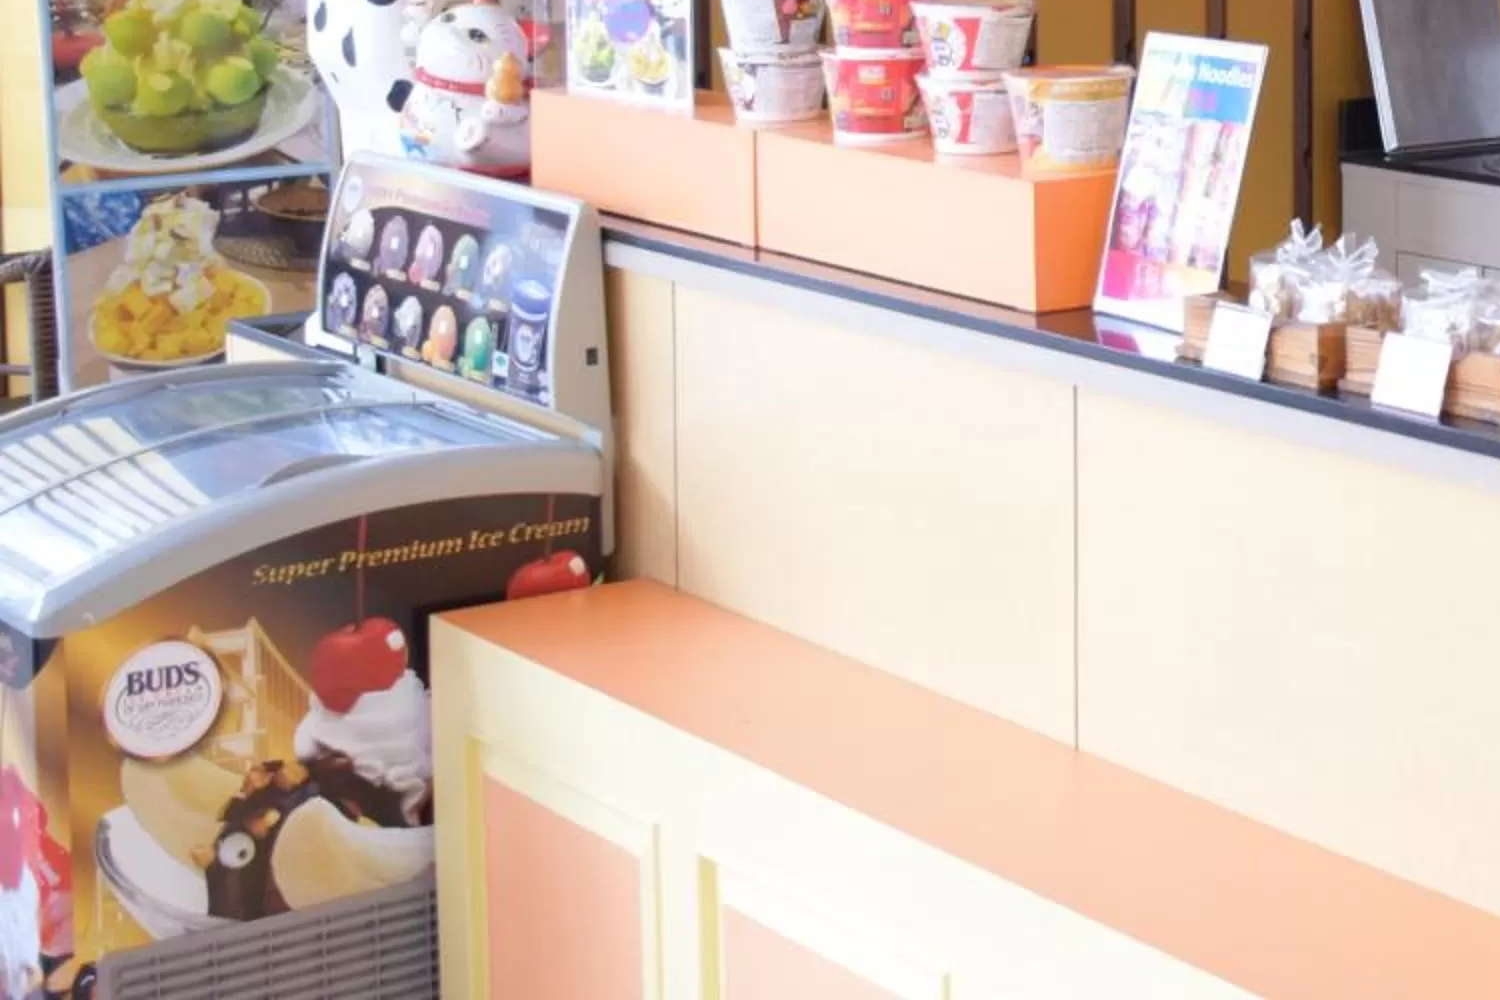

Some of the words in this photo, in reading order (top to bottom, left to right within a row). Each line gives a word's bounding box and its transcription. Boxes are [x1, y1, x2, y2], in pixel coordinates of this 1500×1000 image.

[252, 556, 336, 585] Super
[338, 536, 464, 572] Premium
[468, 528, 505, 551] Ice
[508, 515, 591, 545] Cream
[126, 660, 202, 697] BUDS
